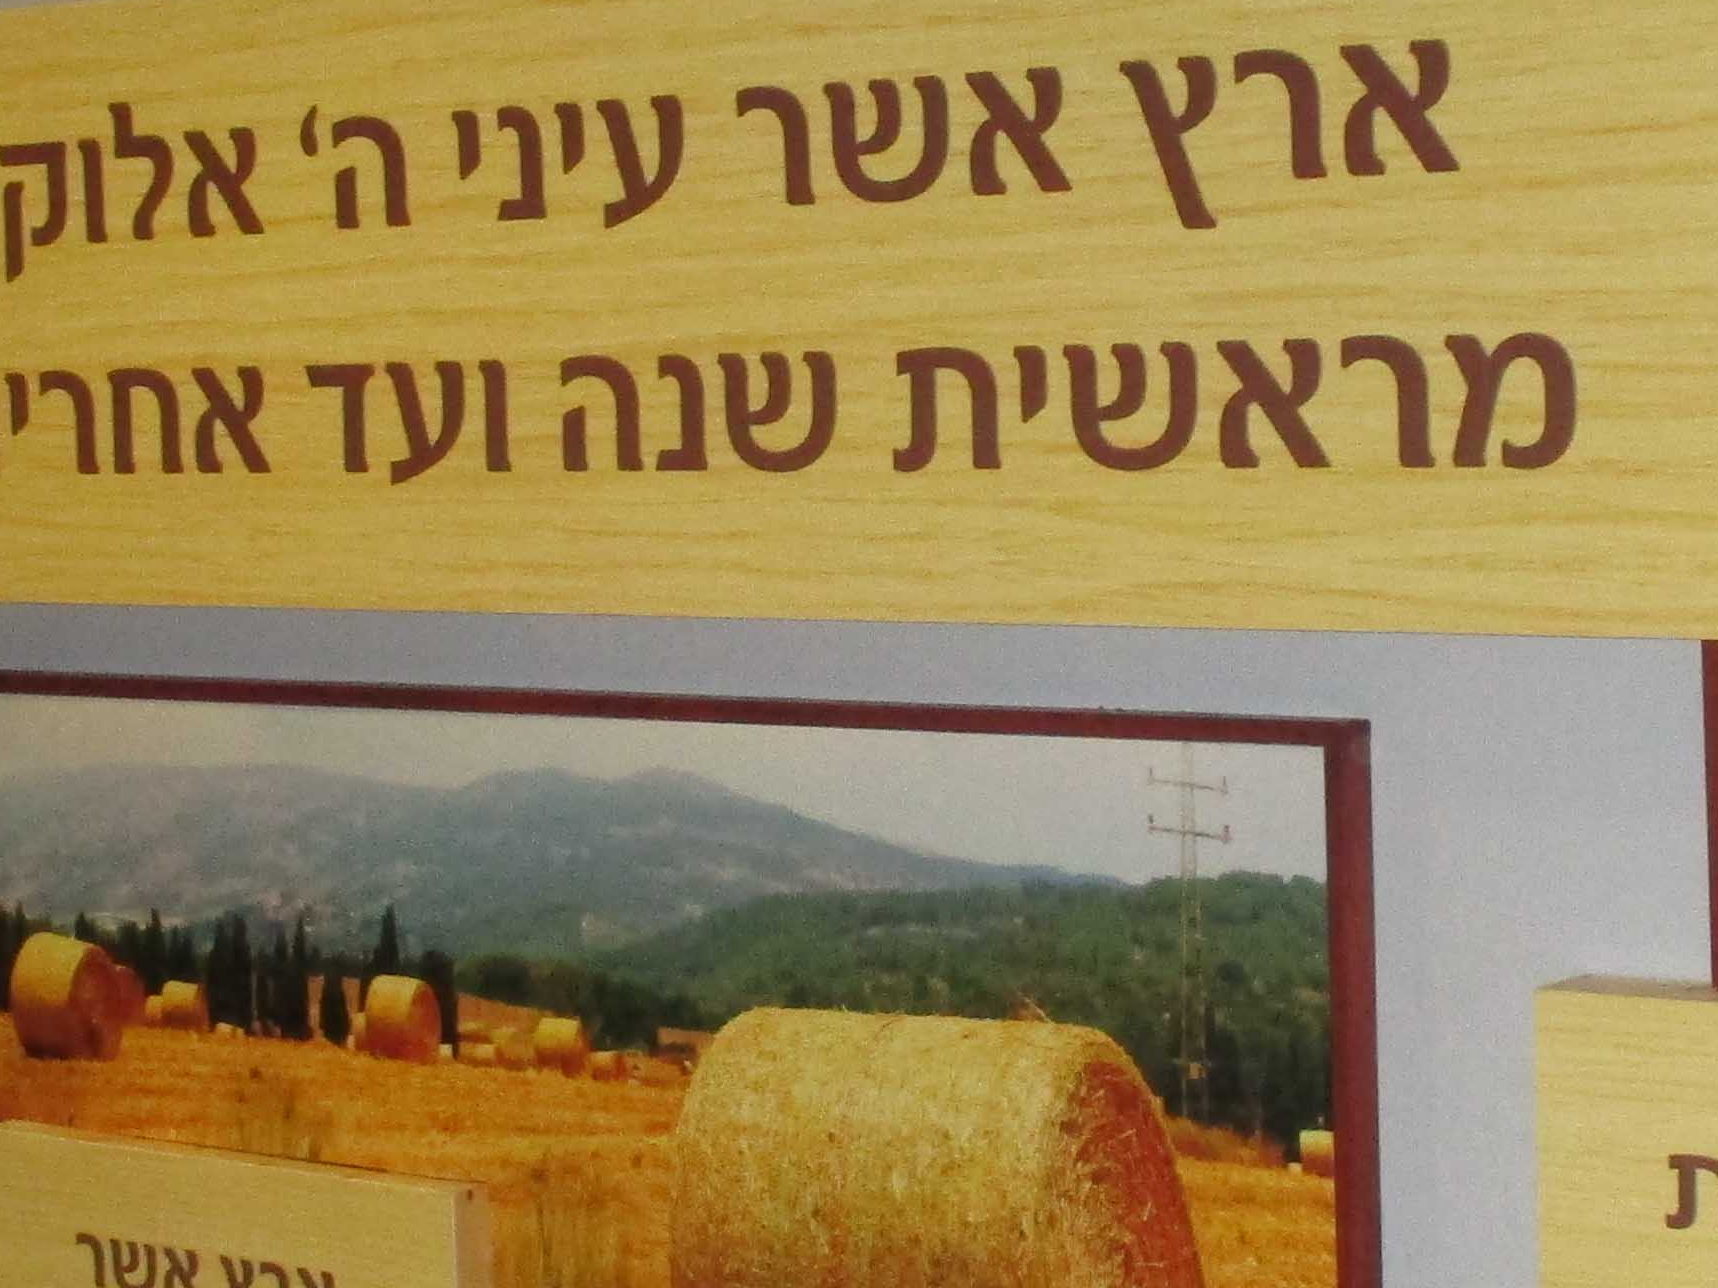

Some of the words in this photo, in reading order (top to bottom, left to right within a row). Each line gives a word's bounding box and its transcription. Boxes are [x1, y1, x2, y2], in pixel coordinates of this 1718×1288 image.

[451, 93, 689, 229] עיני
[736, 64, 1072, 206] אשר
[1122, 37, 1459, 231] ארץ
[305, 359, 514, 485] ועד
[558, 350, 839, 476] שנה
[893, 330, 1581, 472] מראשית
